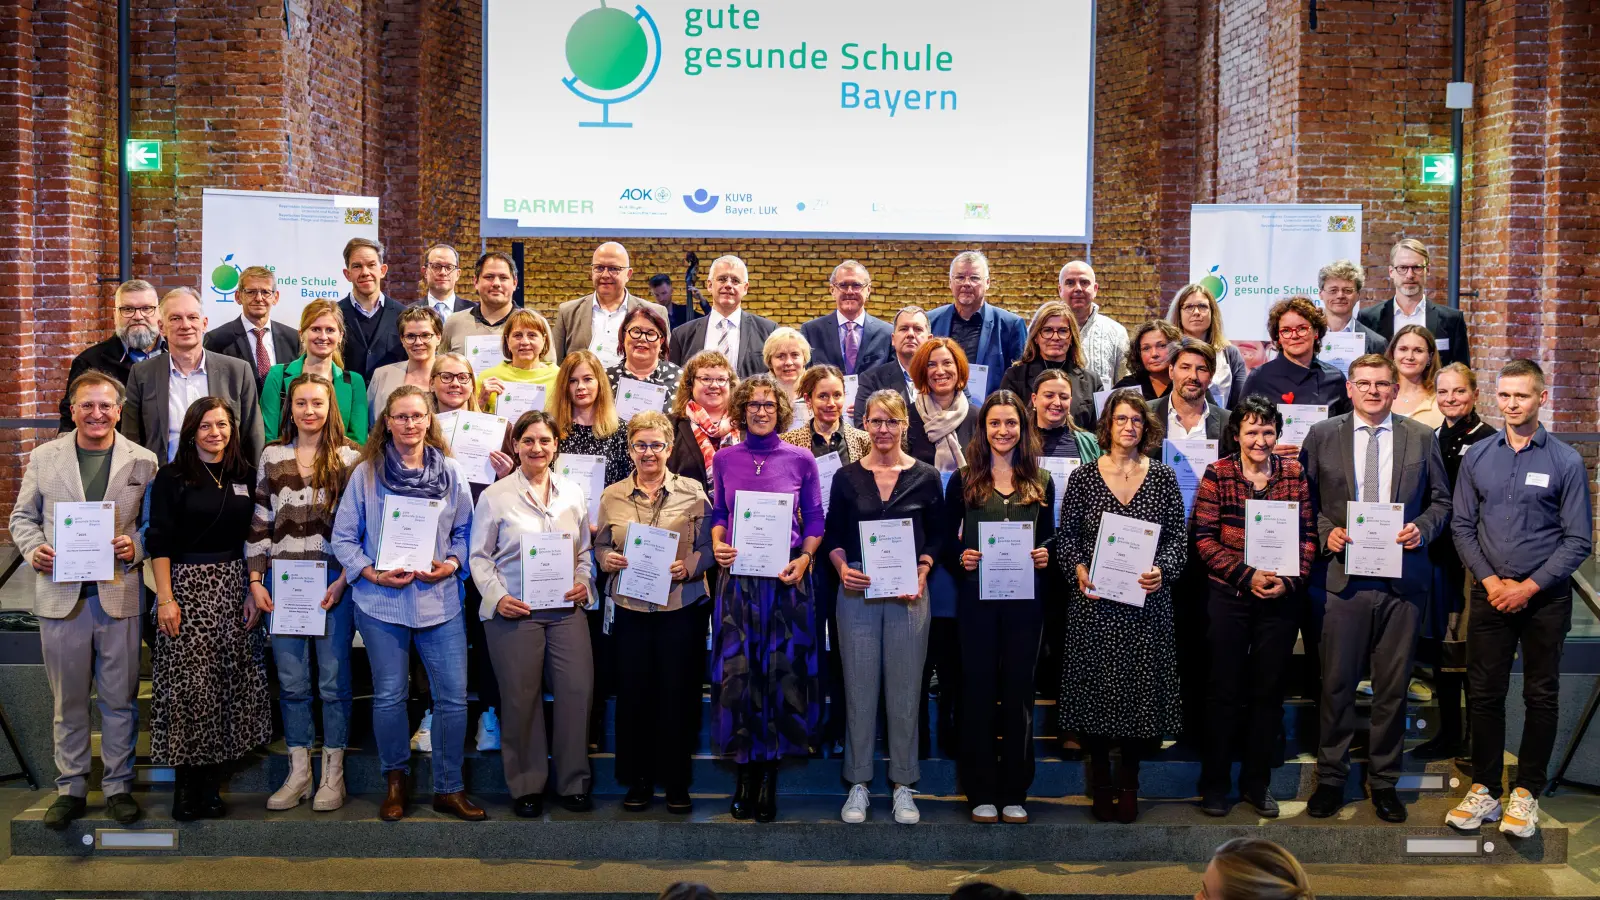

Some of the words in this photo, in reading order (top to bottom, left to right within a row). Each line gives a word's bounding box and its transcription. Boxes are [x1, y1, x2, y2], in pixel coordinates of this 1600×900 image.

[684, 3, 760, 37] gute
[684, 42, 828, 76] gesunde
[841, 43, 953, 71] Schule
[841, 82, 957, 117] Bayern
[620, 188, 653, 200] AOK
[725, 193, 753, 202] KUVB
[503, 198, 594, 214] BARMER
[725, 205, 756, 216] Bayer.
[759, 206, 778, 215] LUK
[301, 276, 337, 286] Schule
[1234, 274, 1259, 284] gute
[301, 288, 339, 298] Bayern
[1234, 286, 1280, 296] gesunde
[1283, 285, 1319, 295] Schule
